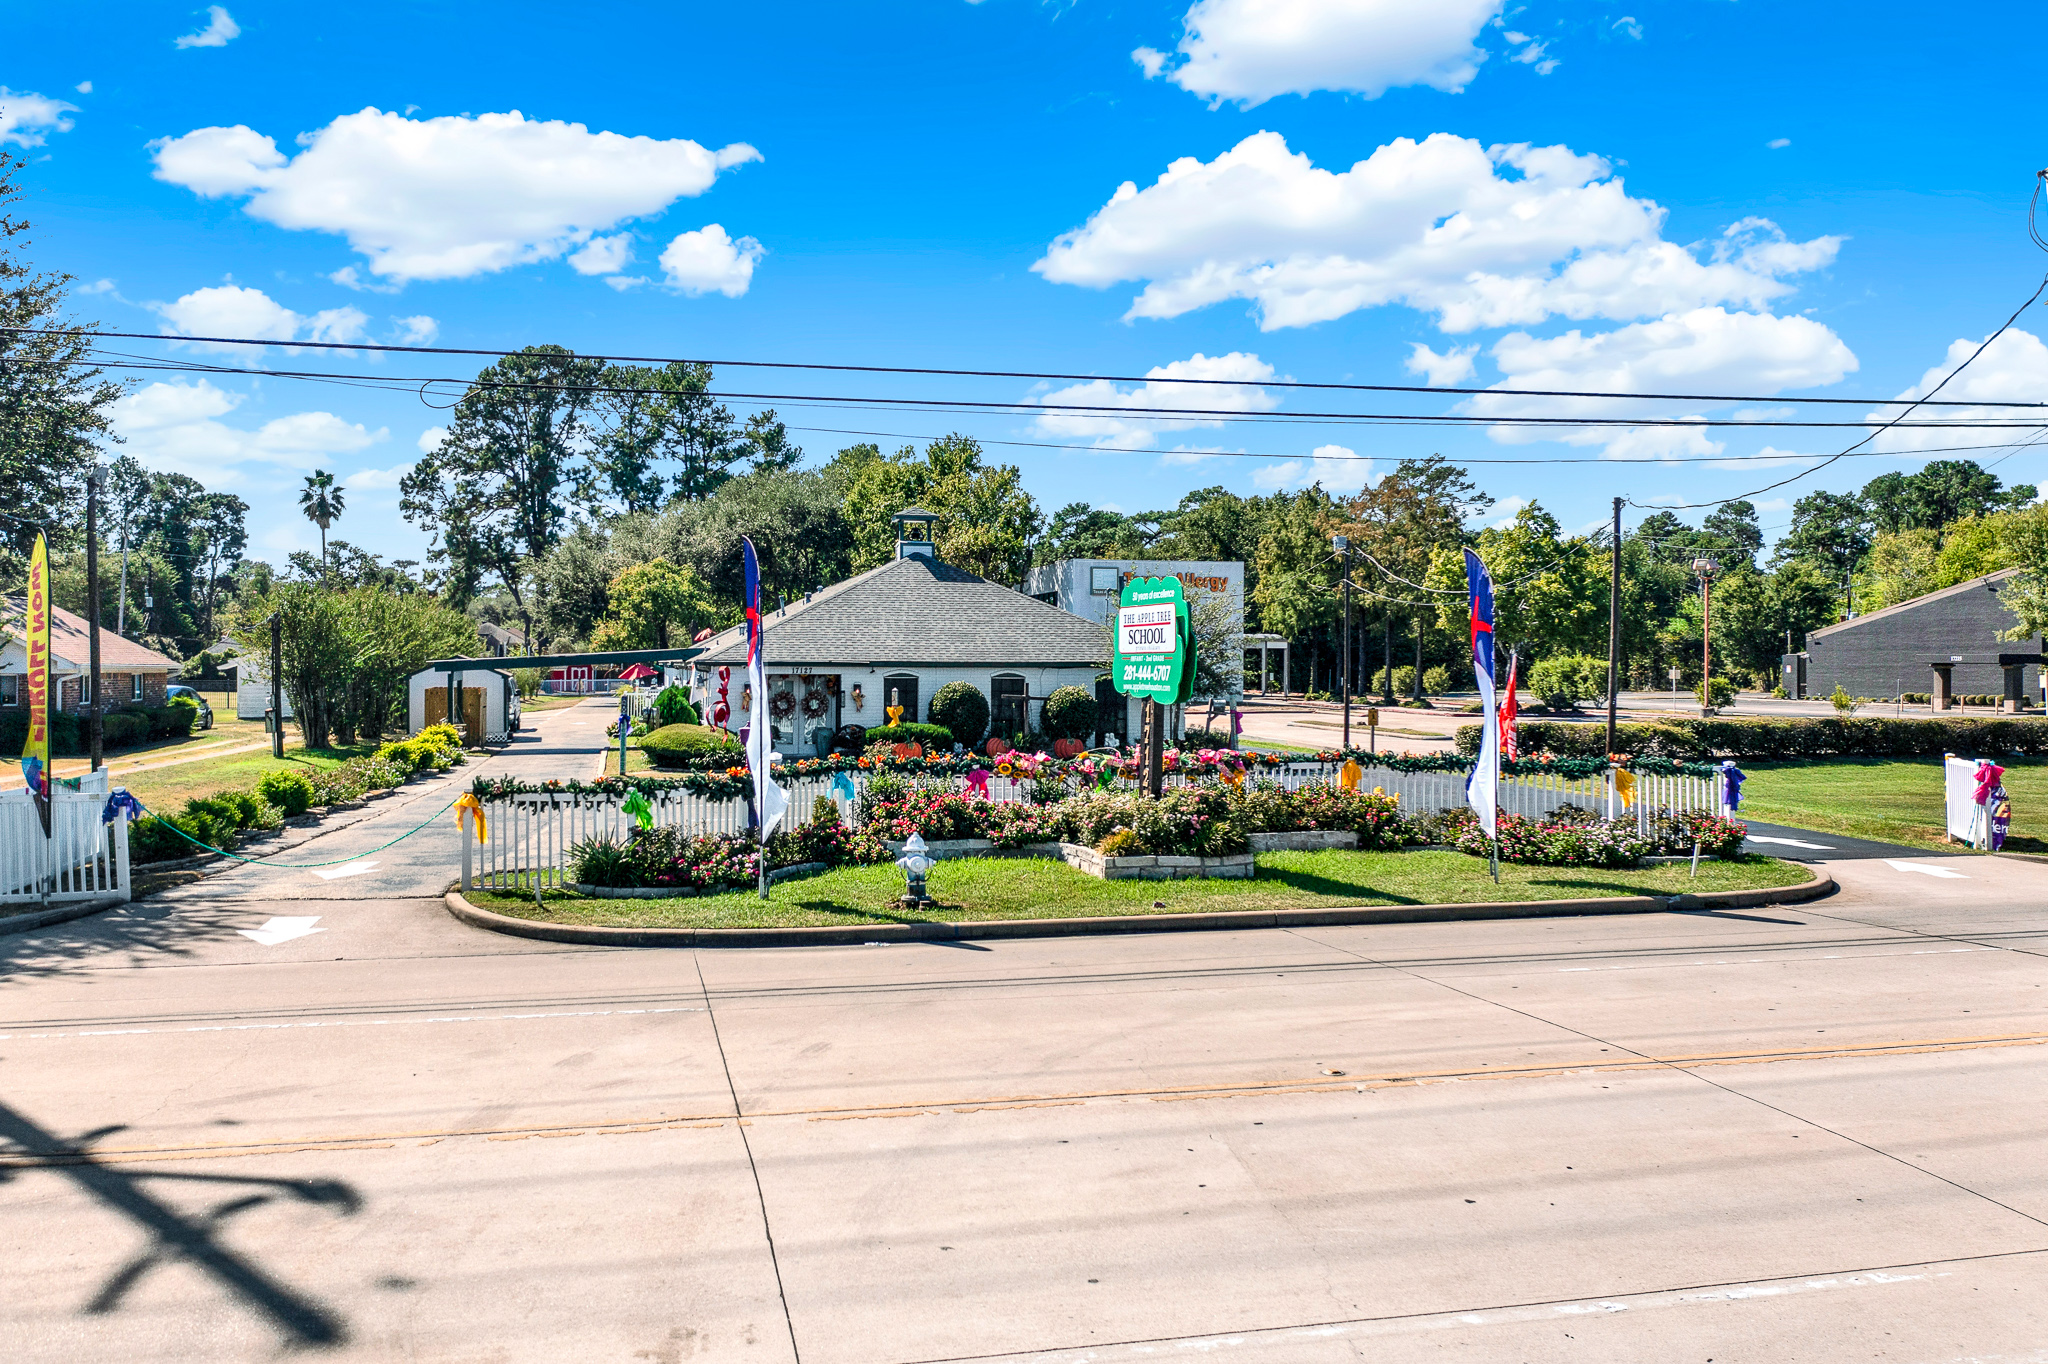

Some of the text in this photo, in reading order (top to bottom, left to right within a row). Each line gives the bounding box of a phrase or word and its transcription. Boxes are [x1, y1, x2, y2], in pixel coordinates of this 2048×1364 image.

[1177, 572, 1229, 592] Allergy
[1123, 610, 1171, 624] THE APPLE TREE
[1128, 627, 1166, 645] SCHOOL
[1123, 665, 1171, 681] 281-444-6707
